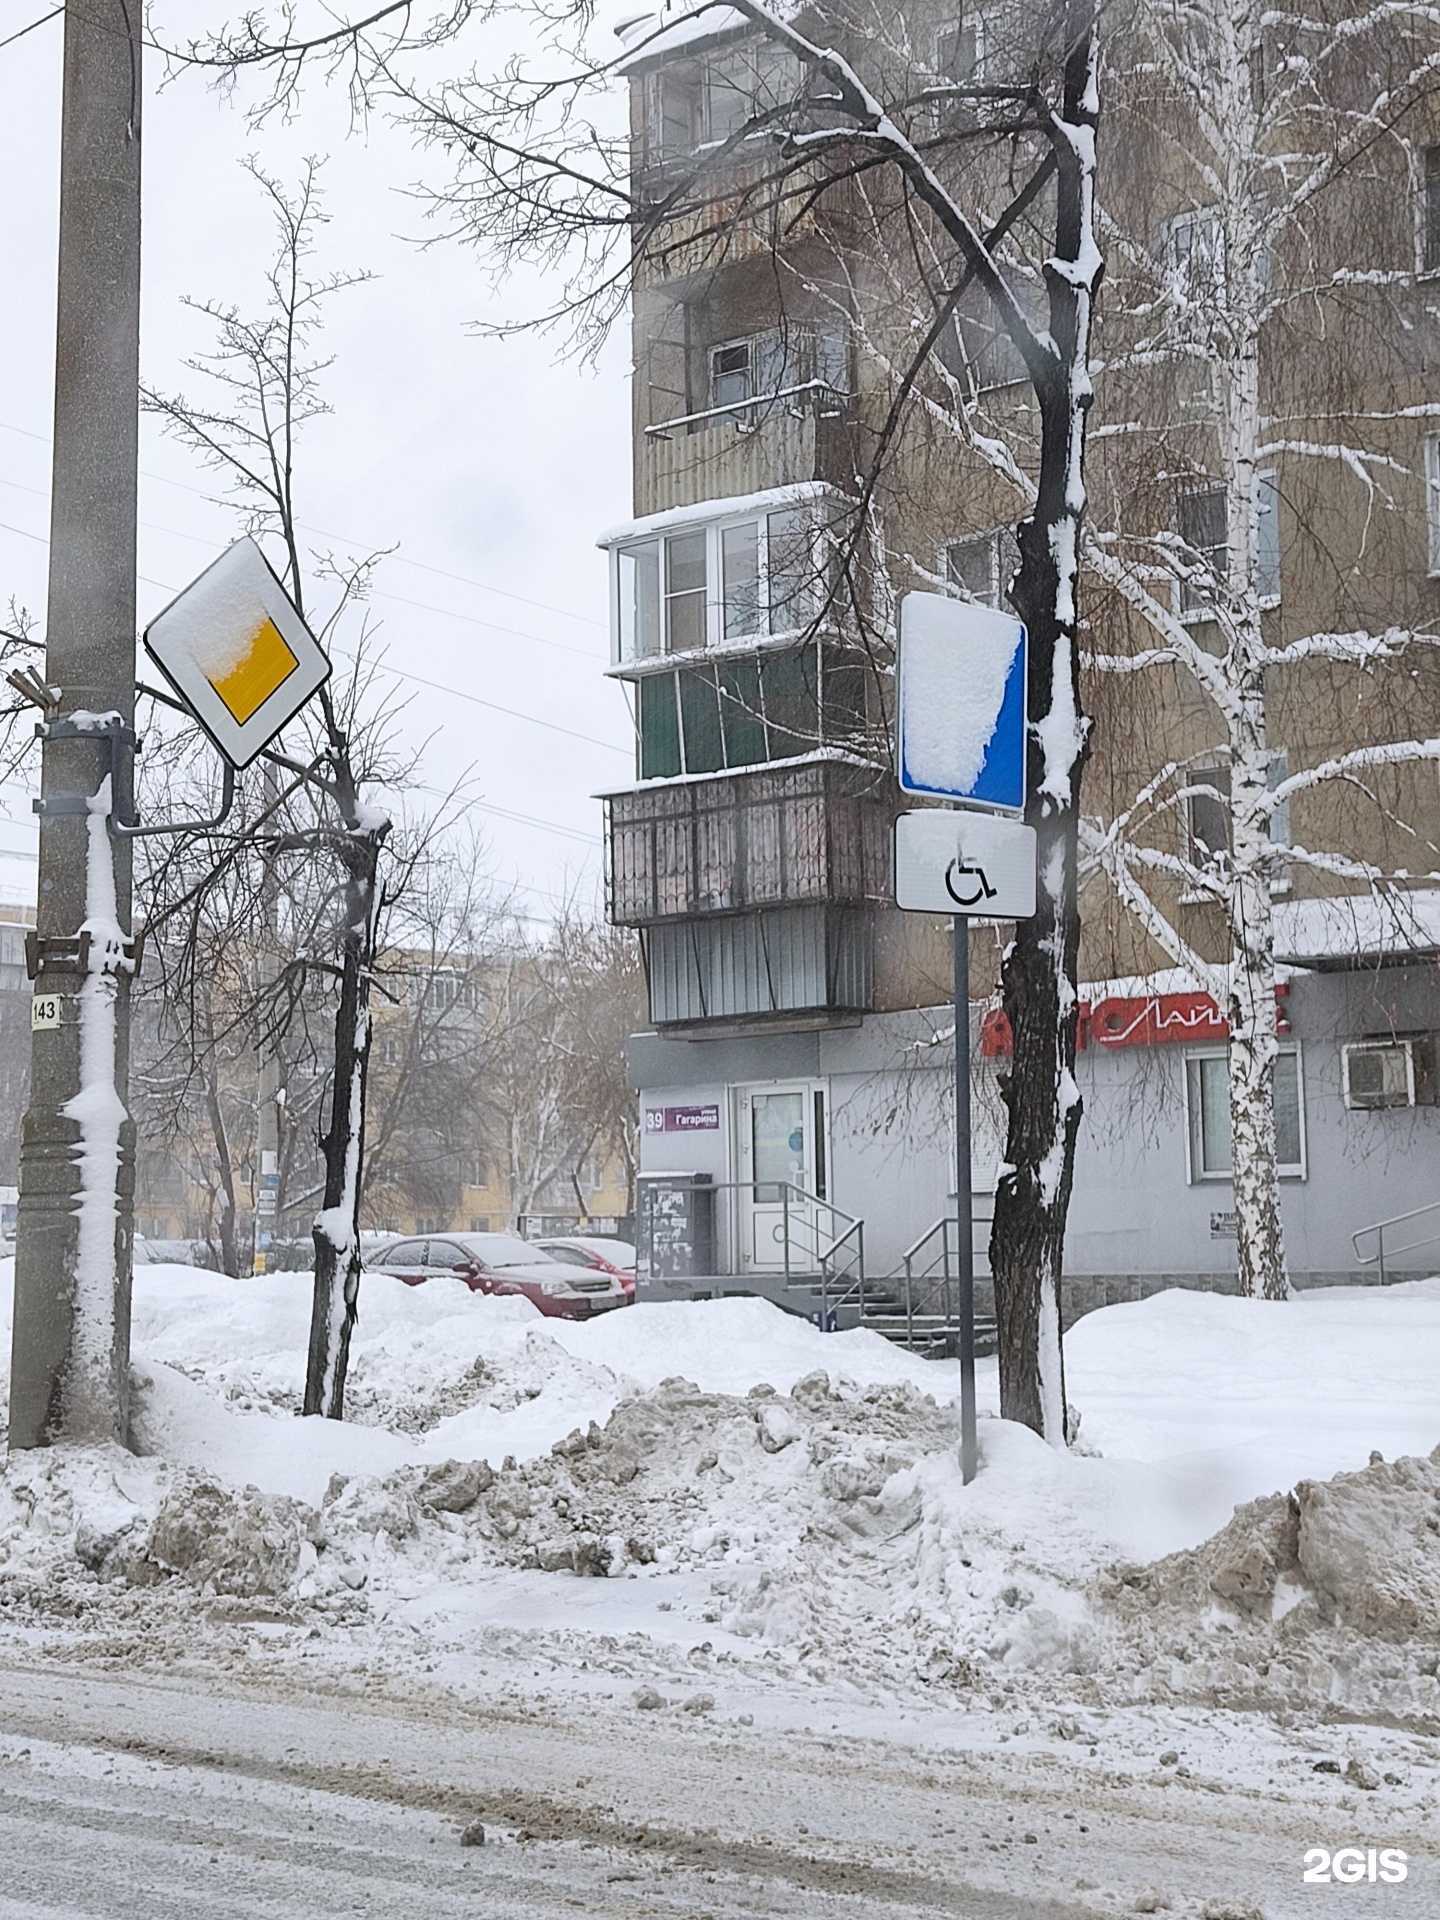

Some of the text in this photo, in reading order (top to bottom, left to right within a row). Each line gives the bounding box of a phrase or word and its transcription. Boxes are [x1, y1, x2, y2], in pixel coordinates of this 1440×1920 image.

[33, 1001, 55, 1021] 143
[646, 1111, 717, 1129] 39 Гагарина
